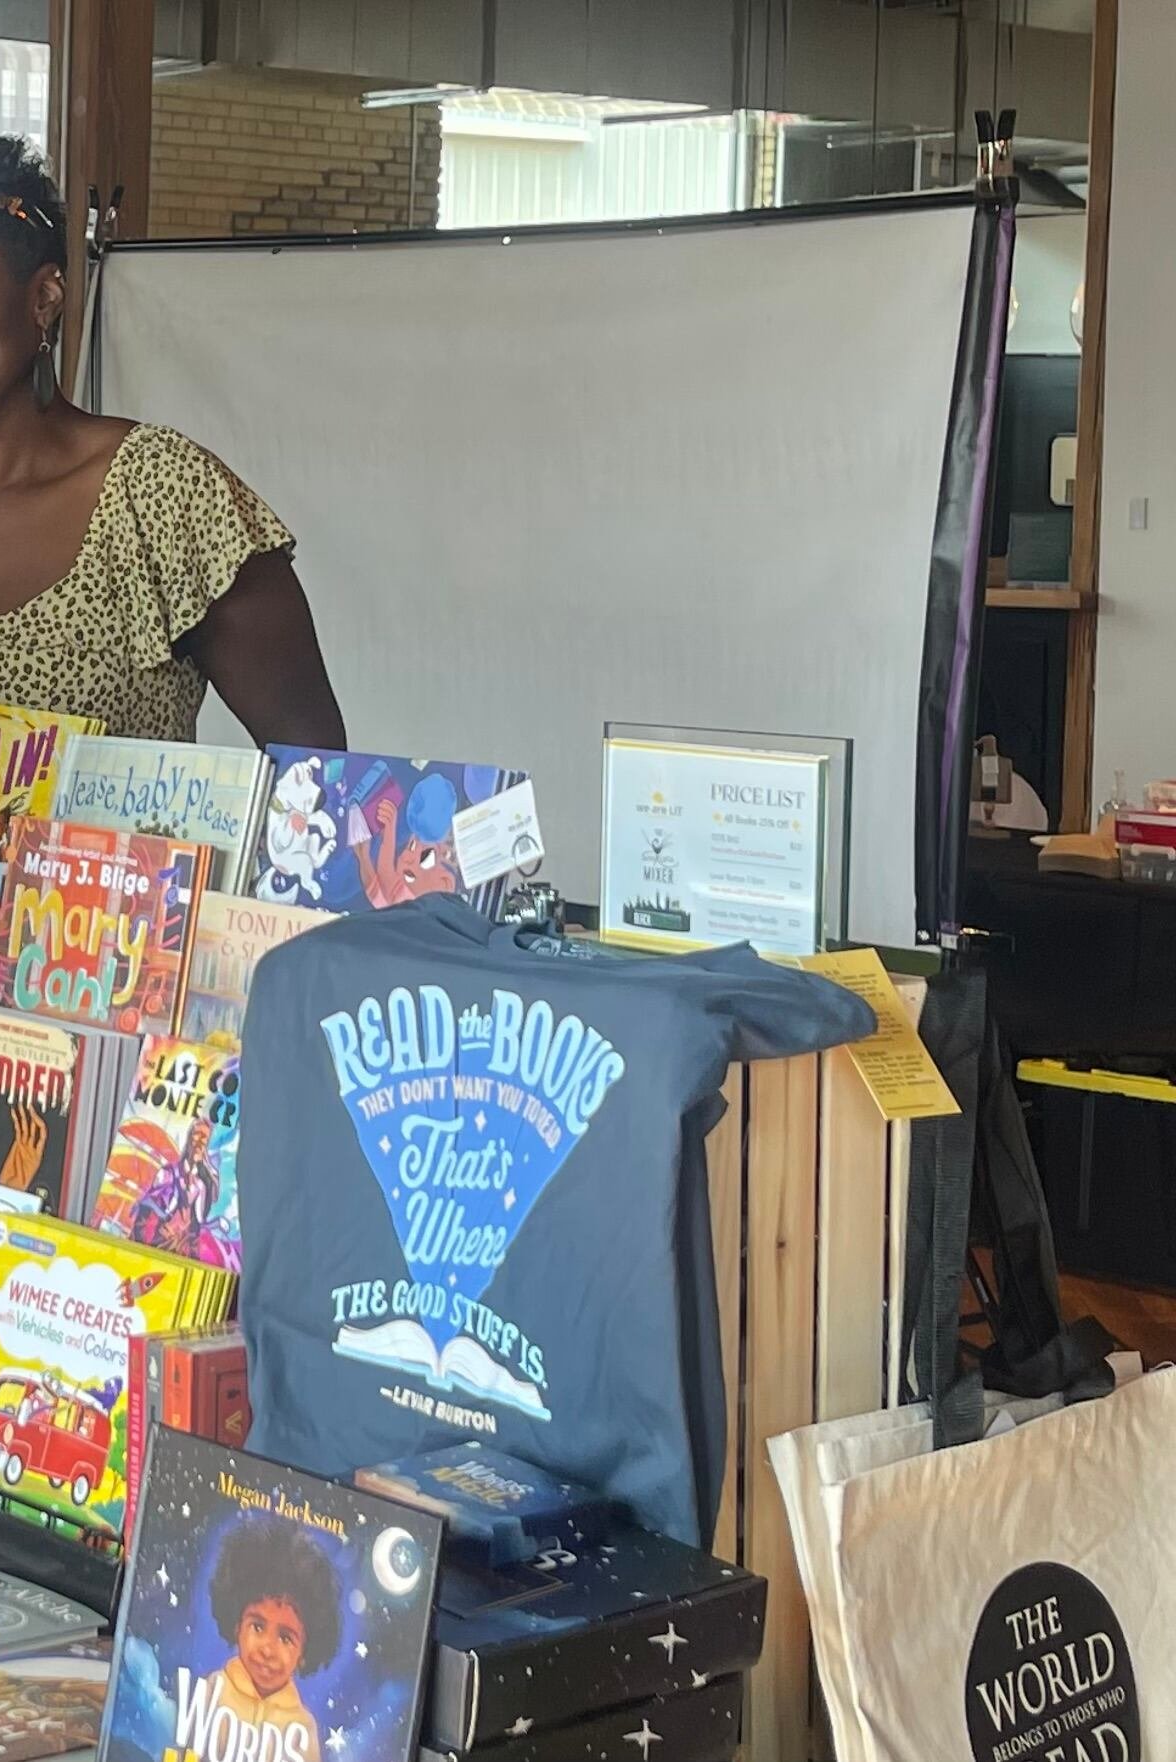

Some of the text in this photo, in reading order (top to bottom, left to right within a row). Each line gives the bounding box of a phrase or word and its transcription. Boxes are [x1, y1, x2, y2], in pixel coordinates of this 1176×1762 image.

[3, 725, 58, 794] IN!
[181, 777, 240, 838] please
[710, 783, 806, 810] PRICE LIST
[24, 851, 150, 896] Mary J. Blige
[643, 866, 674, 884] MIXER
[8, 883, 148, 1005] Mary
[226, 908, 277, 938] TONI
[155, 1055, 205, 1088] LAST
[320, 985, 625, 1135] READ the BOOKS
[134, 1080, 205, 1119] MONTE
[357, 1086, 395, 1121] THEY
[400, 1076, 448, 1105] DON'T
[452, 1075, 495, 1102] WANT
[497, 1081, 524, 1113] YOU
[399, 1113, 513, 1190] That's
[405, 1191, 507, 1267] Where
[10, 1280, 133, 1338] WIMEE CREATES
[16, 1310, 64, 1344] Vehicles
[65, 1334, 83, 1349] and
[84, 1333, 127, 1366] Colors
[332, 1279, 387, 1322] THE
[392, 1279, 446, 1319] GOOD
[449, 1292, 519, 1358] STUFF
[435, 1401, 497, 1434] BURTON
[217, 1471, 344, 1536] Megan Jackson
[1005, 1596, 1063, 1650] THE
[975, 1632, 1115, 1733] WORLD
[176, 1667, 309, 1762] WORDS
[992, 1686, 1125, 1762] BELONGS TO THOSE WHO
